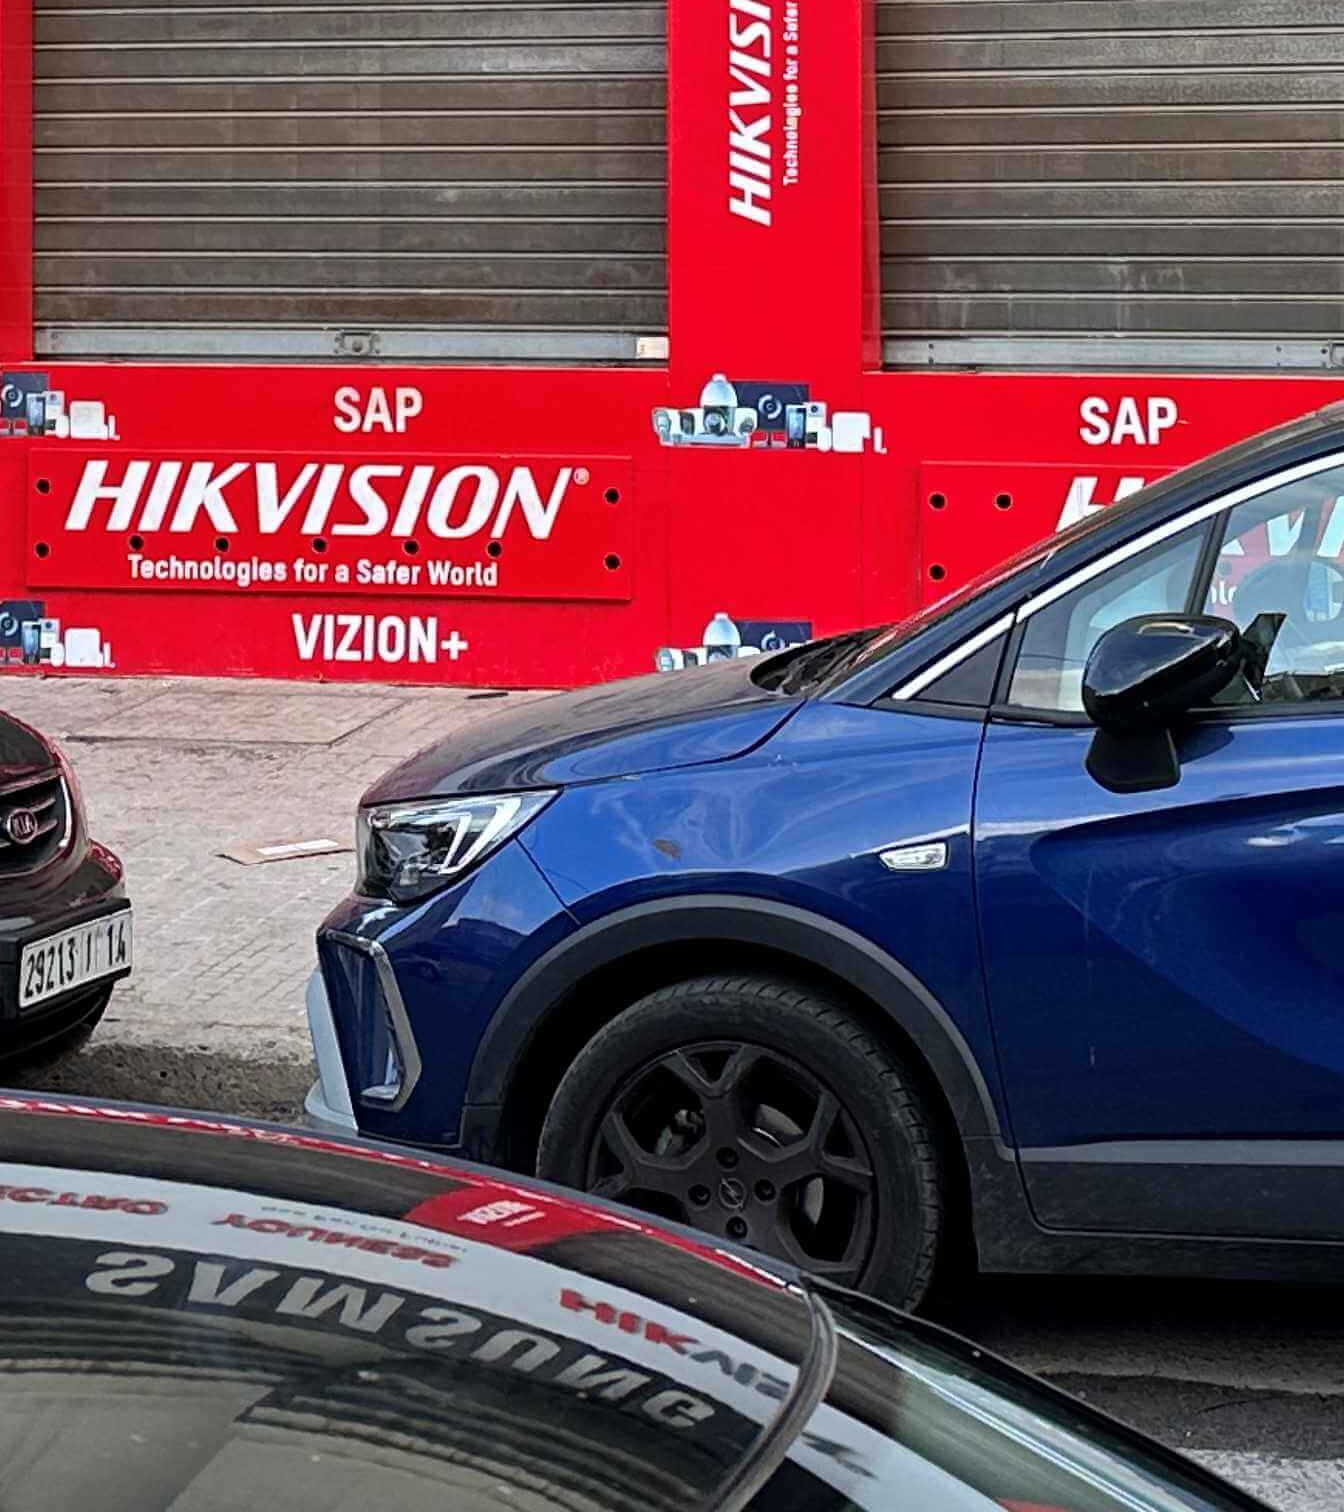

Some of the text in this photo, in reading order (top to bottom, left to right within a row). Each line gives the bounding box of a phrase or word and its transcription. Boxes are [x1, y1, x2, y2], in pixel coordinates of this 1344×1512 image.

[782, 1, 799, 41] Safer
[782, 58, 799, 81] for
[782, 83, 802, 186] Technologies
[334, 386, 423, 433] SAP
[1079, 396, 1178, 445] SAP
[128, 553, 498, 587] Technologies for a Safer World
[292, 613, 469, 663] VIZION+
[24, 937, 76, 999] 29213
